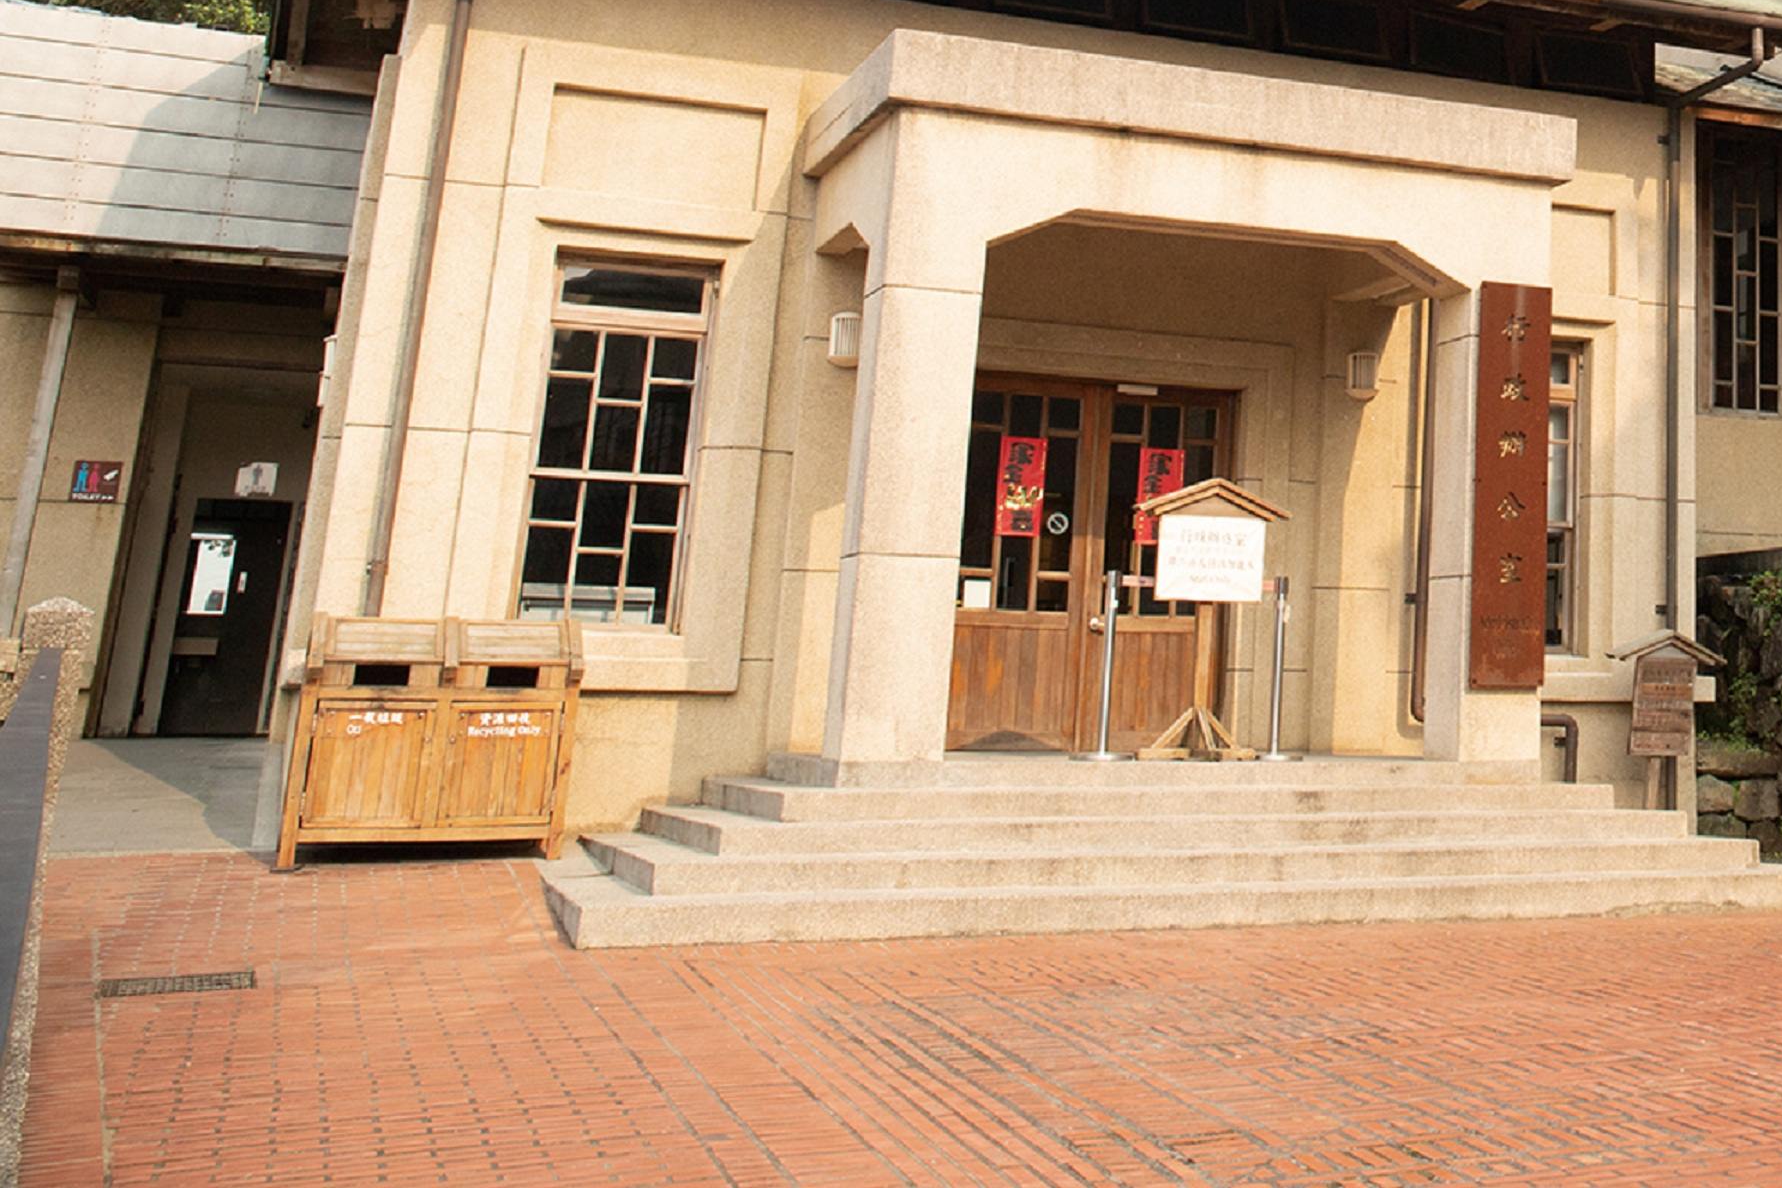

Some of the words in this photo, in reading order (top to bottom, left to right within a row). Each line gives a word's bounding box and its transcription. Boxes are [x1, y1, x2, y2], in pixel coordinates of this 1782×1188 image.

[1498, 313, 1530, 583] 行政辦公室
[72, 492, 101, 500] TOILET
[480, 712, 530, 726] 資源回收
[467, 726, 516, 737] Recycling
[517, 725, 541, 737] Only
